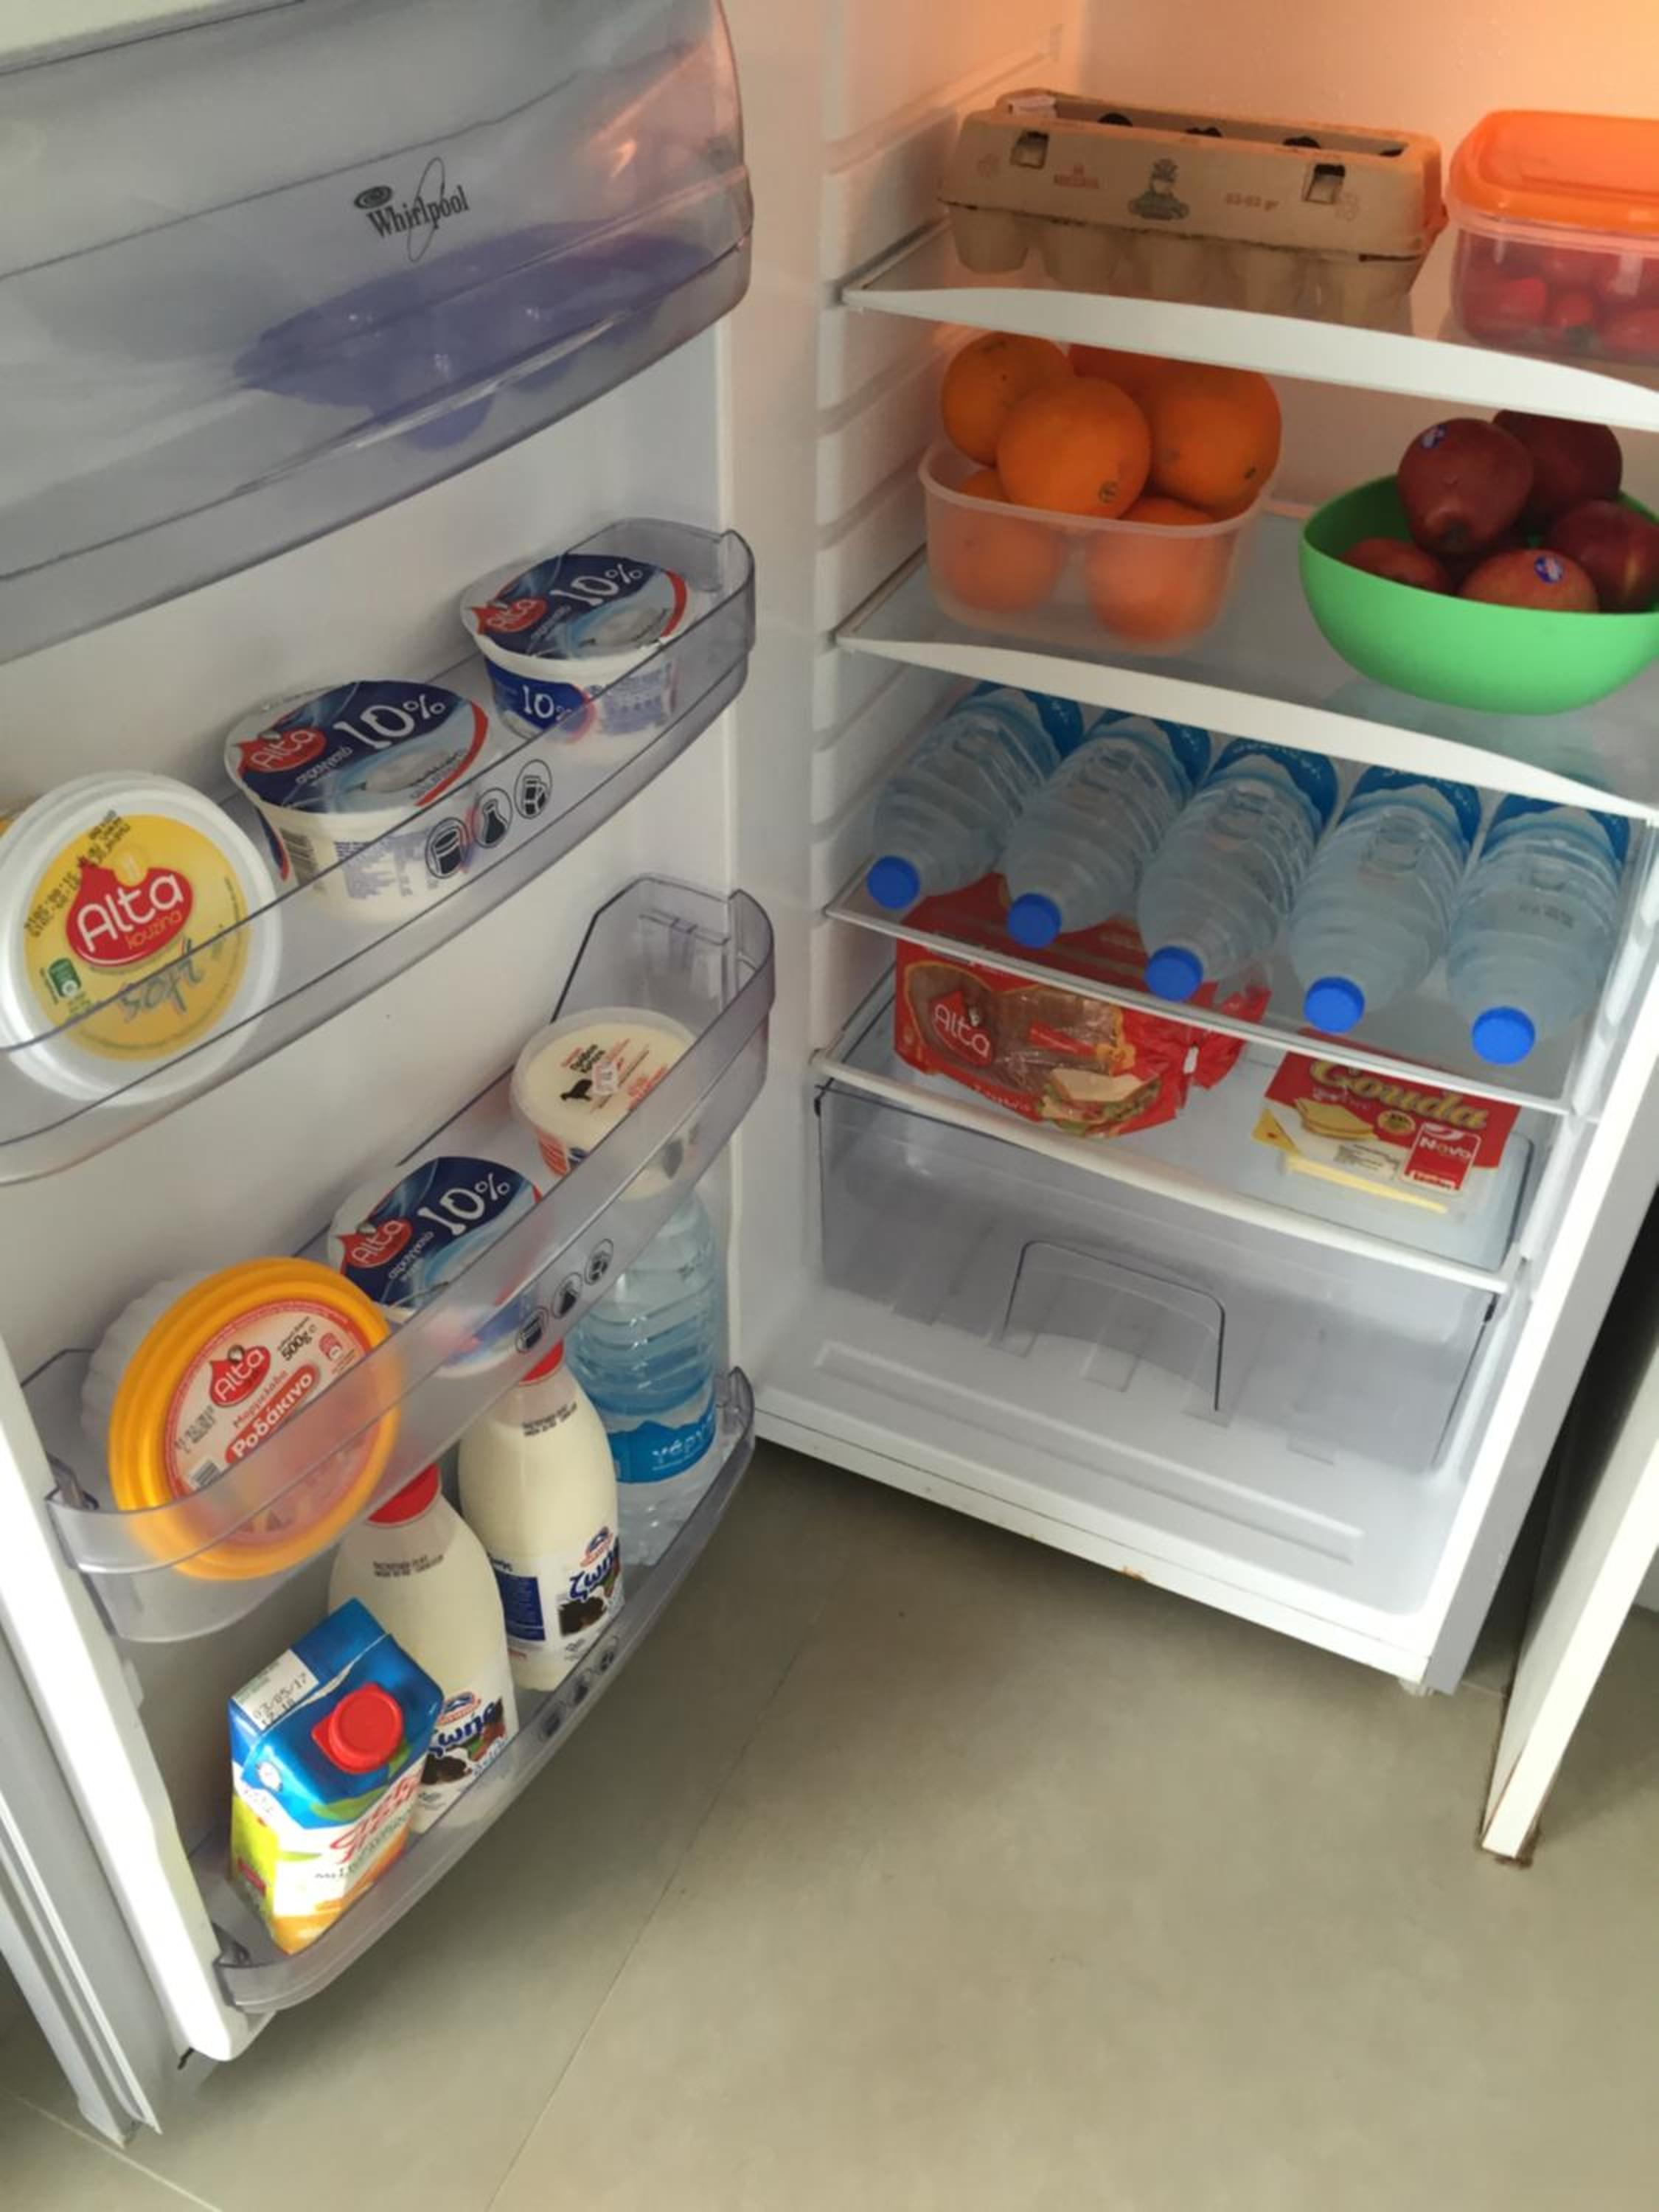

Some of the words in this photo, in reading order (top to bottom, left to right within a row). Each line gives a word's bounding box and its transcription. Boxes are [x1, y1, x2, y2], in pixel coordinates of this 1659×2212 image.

[366, 184, 470, 238] Whirlpool
[549, 563, 643, 606] 10%
[333, 694, 446, 751] 10%
[250, 728, 316, 770] Alta
[77, 874, 184, 953] Alta
[125, 911, 182, 950] kouzina
[933, 1004, 990, 1056] Alta
[1310, 1060, 1488, 1130] Gouda
[417, 1172, 511, 1236] 10%
[352, 1220, 404, 1265] Alta
[281, 1330, 313, 1361] 500g
[215, 1349, 265, 1401] Alta
[231, 1373, 313, 1458] Ροδάκινο
